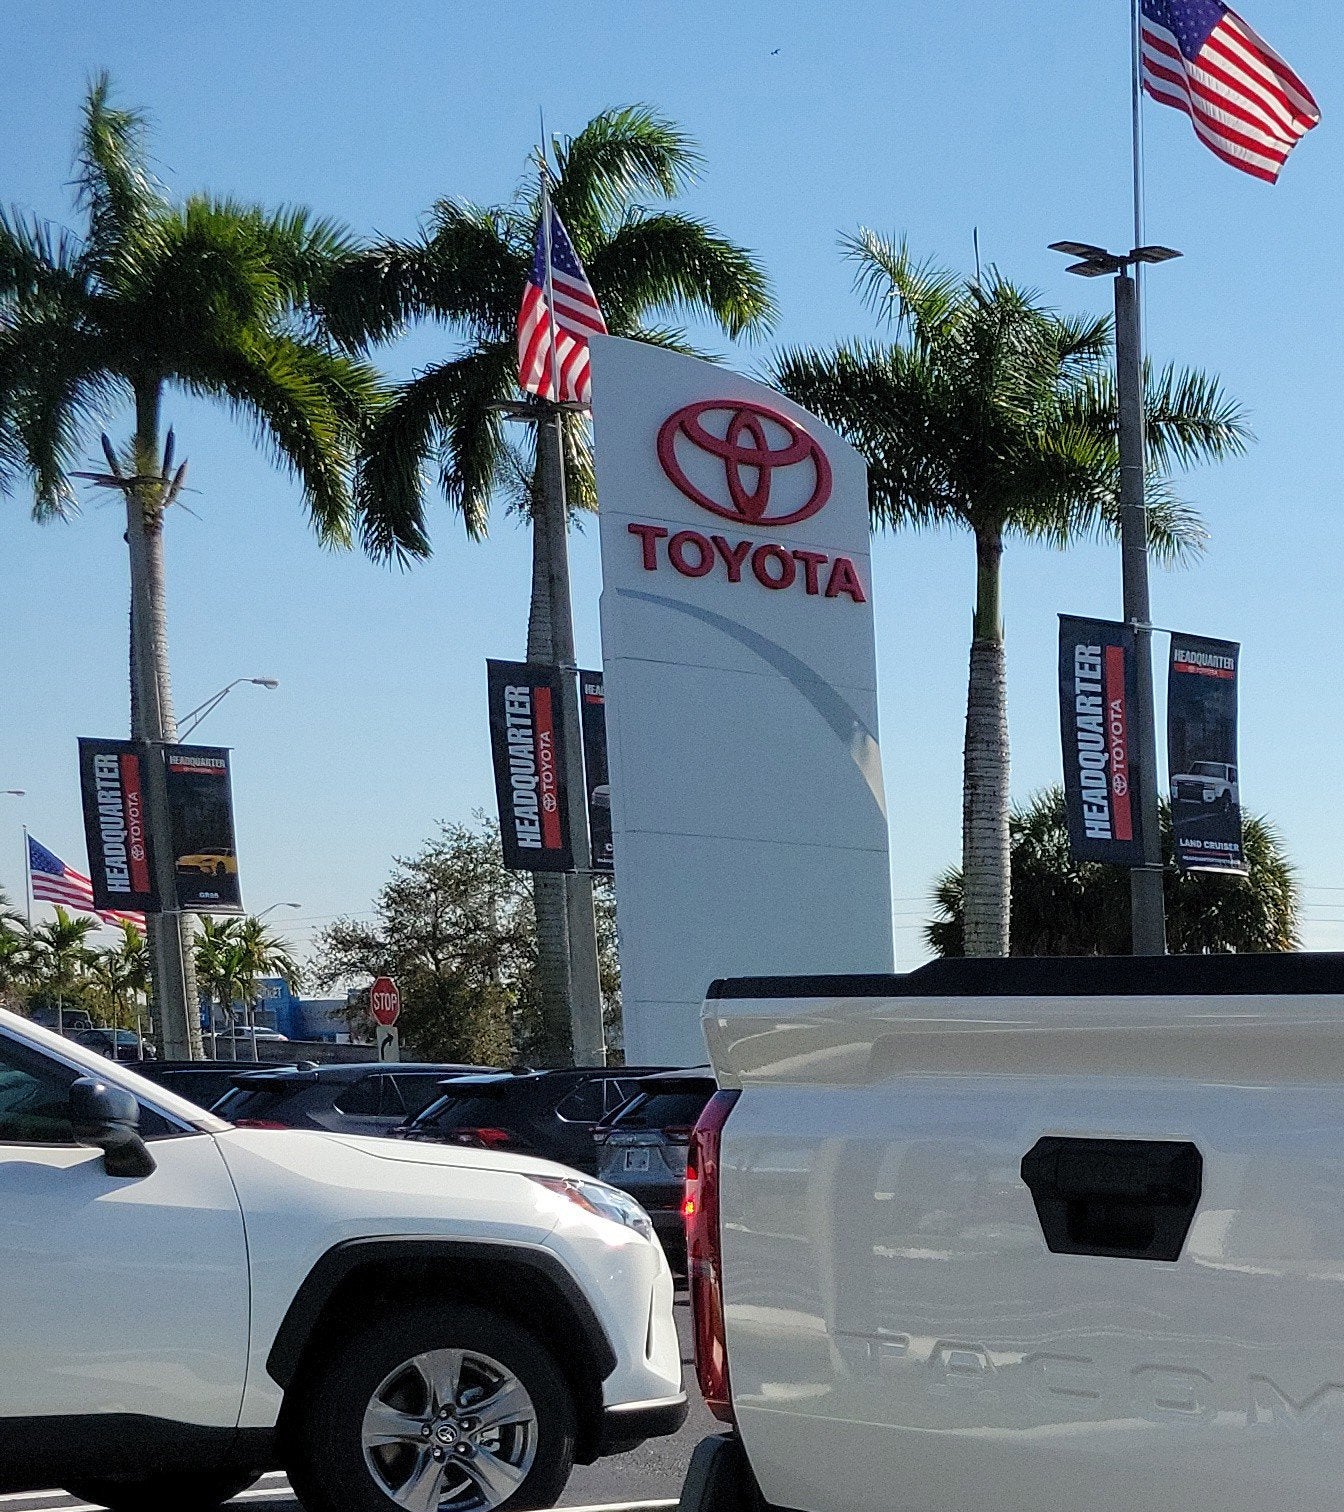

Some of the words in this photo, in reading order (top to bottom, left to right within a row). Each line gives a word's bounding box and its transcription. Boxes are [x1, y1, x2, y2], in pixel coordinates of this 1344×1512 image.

[628, 523, 866, 603] TOYOTA
[1174, 648, 1235, 670] HEADQUARTER
[170, 755, 225, 768] HEADQUARTER
[540, 731, 554, 792] TOYOTA
[1075, 644, 1112, 840] HEADQUARTER
[1109, 699, 1126, 771] TOYOTA
[504, 684, 542, 849] HEADQUARTER
[94, 754, 131, 893] HEADQUARTER
[128, 792, 141, 847] TOYOTA
[1180, 838, 1202, 848] LAND
[1203, 841, 1240, 851] CRUISER
[373, 992, 397, 1011] STOP
